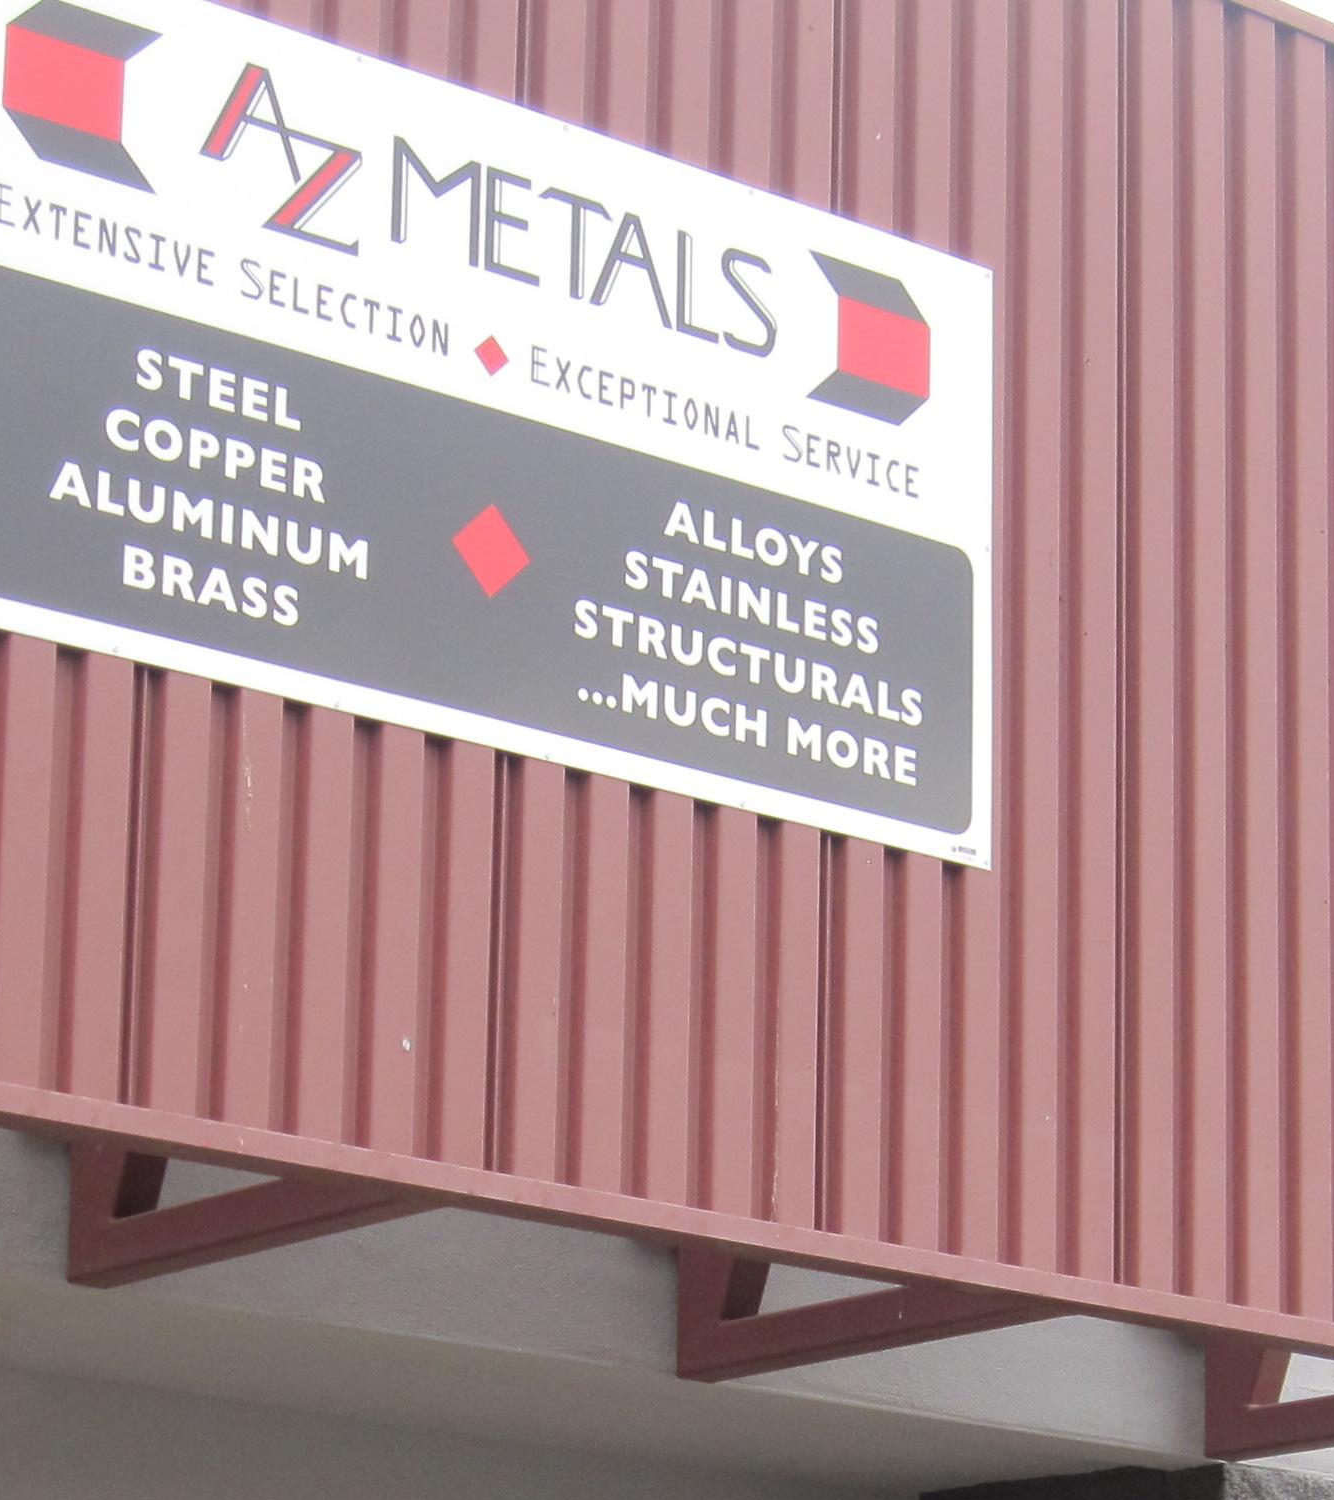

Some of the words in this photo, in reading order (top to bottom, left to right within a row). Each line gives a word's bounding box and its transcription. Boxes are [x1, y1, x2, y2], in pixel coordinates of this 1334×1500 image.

[199, 62, 363, 257] AZ
[390, 134, 777, 358] METALS
[135, 348, 302, 432] STEEL
[240, 257, 450, 356] SELECTION
[530, 344, 760, 450] EXCEPTIONAL
[782, 424, 920, 499] SERVICE
[105, 408, 326, 504] COPPER
[49, 460, 369, 581] ALUMINUM
[663, 500, 843, 584] ALLOYS
[122, 544, 300, 627] BRASS
[624, 549, 880, 654] STAINLESS
[574, 598, 923, 727] STRUCTURALS
[786, 715, 918, 787] MORE
